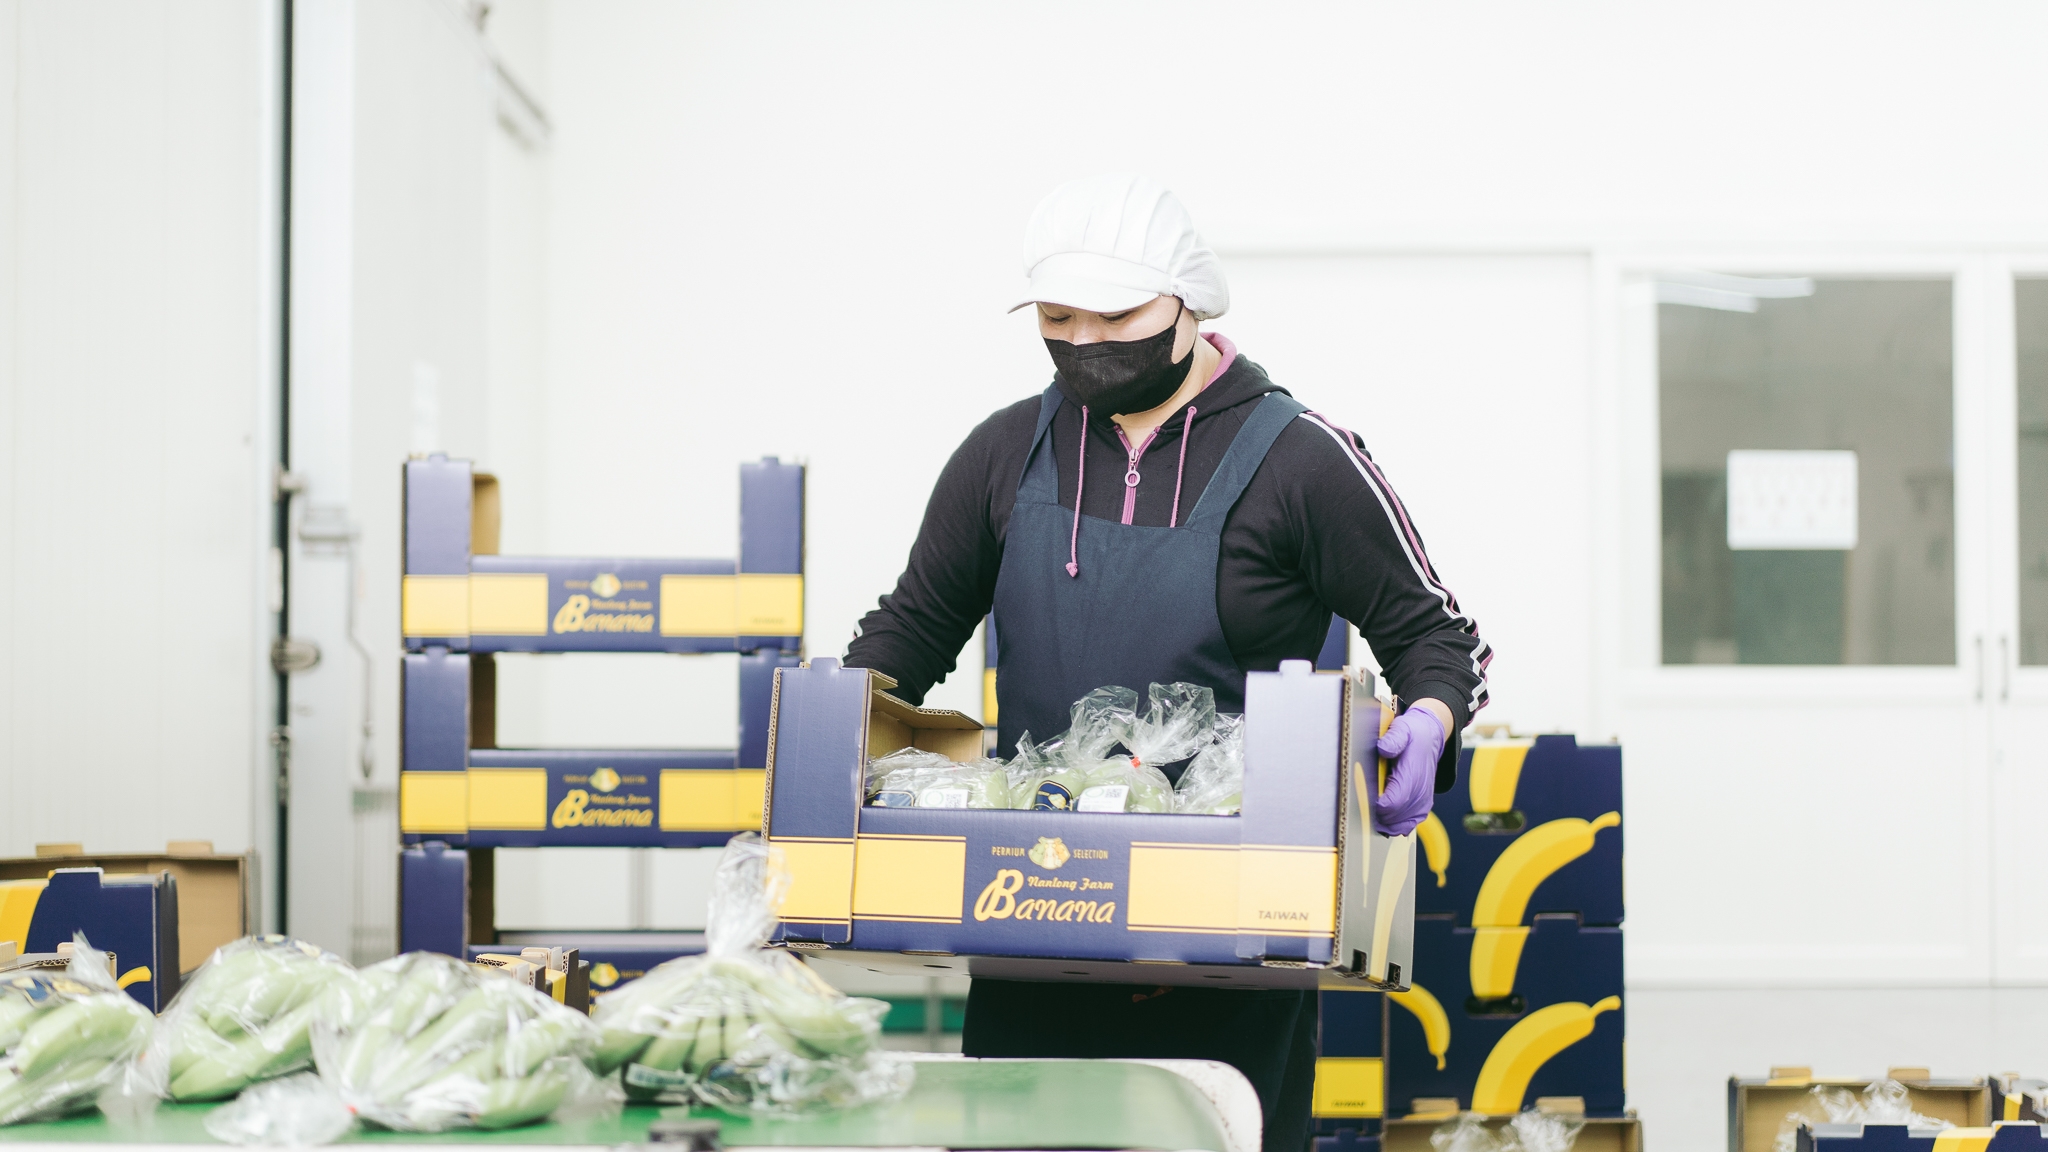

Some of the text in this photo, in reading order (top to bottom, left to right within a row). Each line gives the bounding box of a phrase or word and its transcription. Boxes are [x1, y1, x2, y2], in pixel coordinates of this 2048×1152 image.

[553, 594, 655, 634] Banana
[552, 788, 654, 829] Banana
[1073, 849, 1109, 860] SELECTION
[974, 868, 1116, 924] Banana
[1027, 875, 1114, 892] Nanlong Farm
[1258, 910, 1309, 922] TAIWAN
